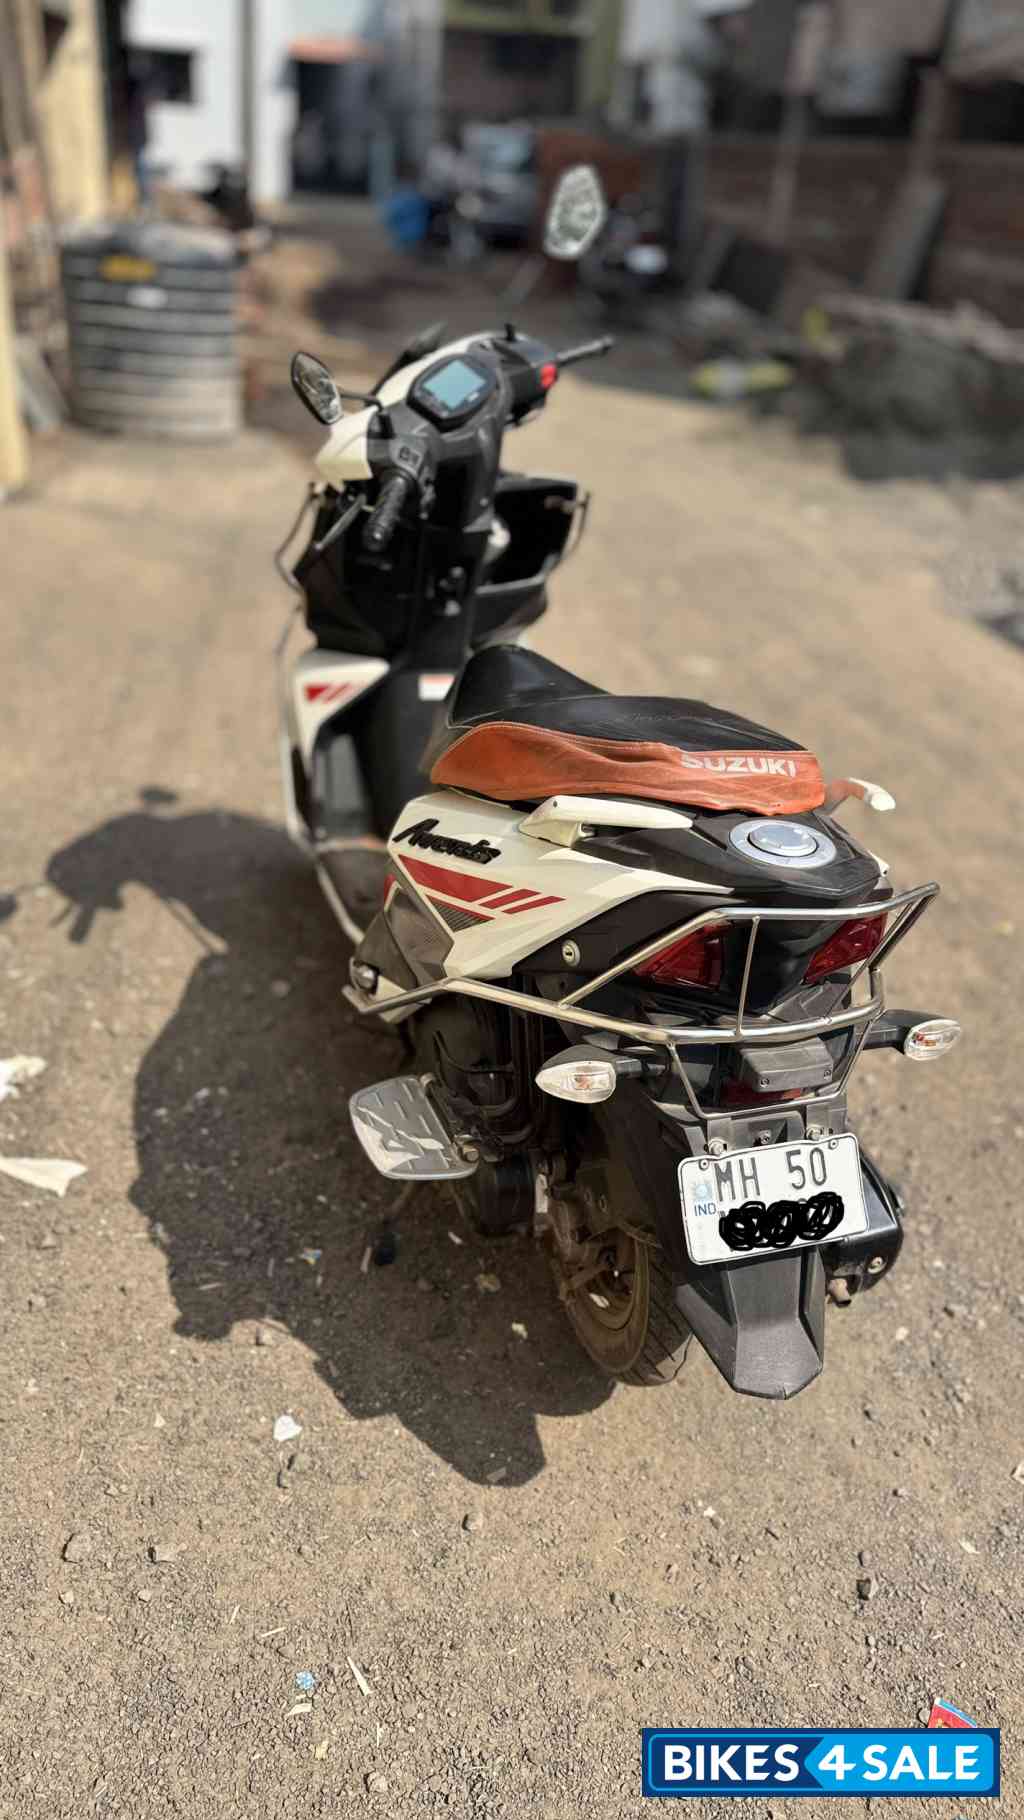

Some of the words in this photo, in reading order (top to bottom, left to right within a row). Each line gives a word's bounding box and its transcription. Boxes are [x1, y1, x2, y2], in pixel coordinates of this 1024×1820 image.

[680, 753, 796, 778] SUZUKI
[714, 1157, 761, 1202] MH
[785, 1147, 827, 1190] 50
[693, 1202, 717, 1217] IND
